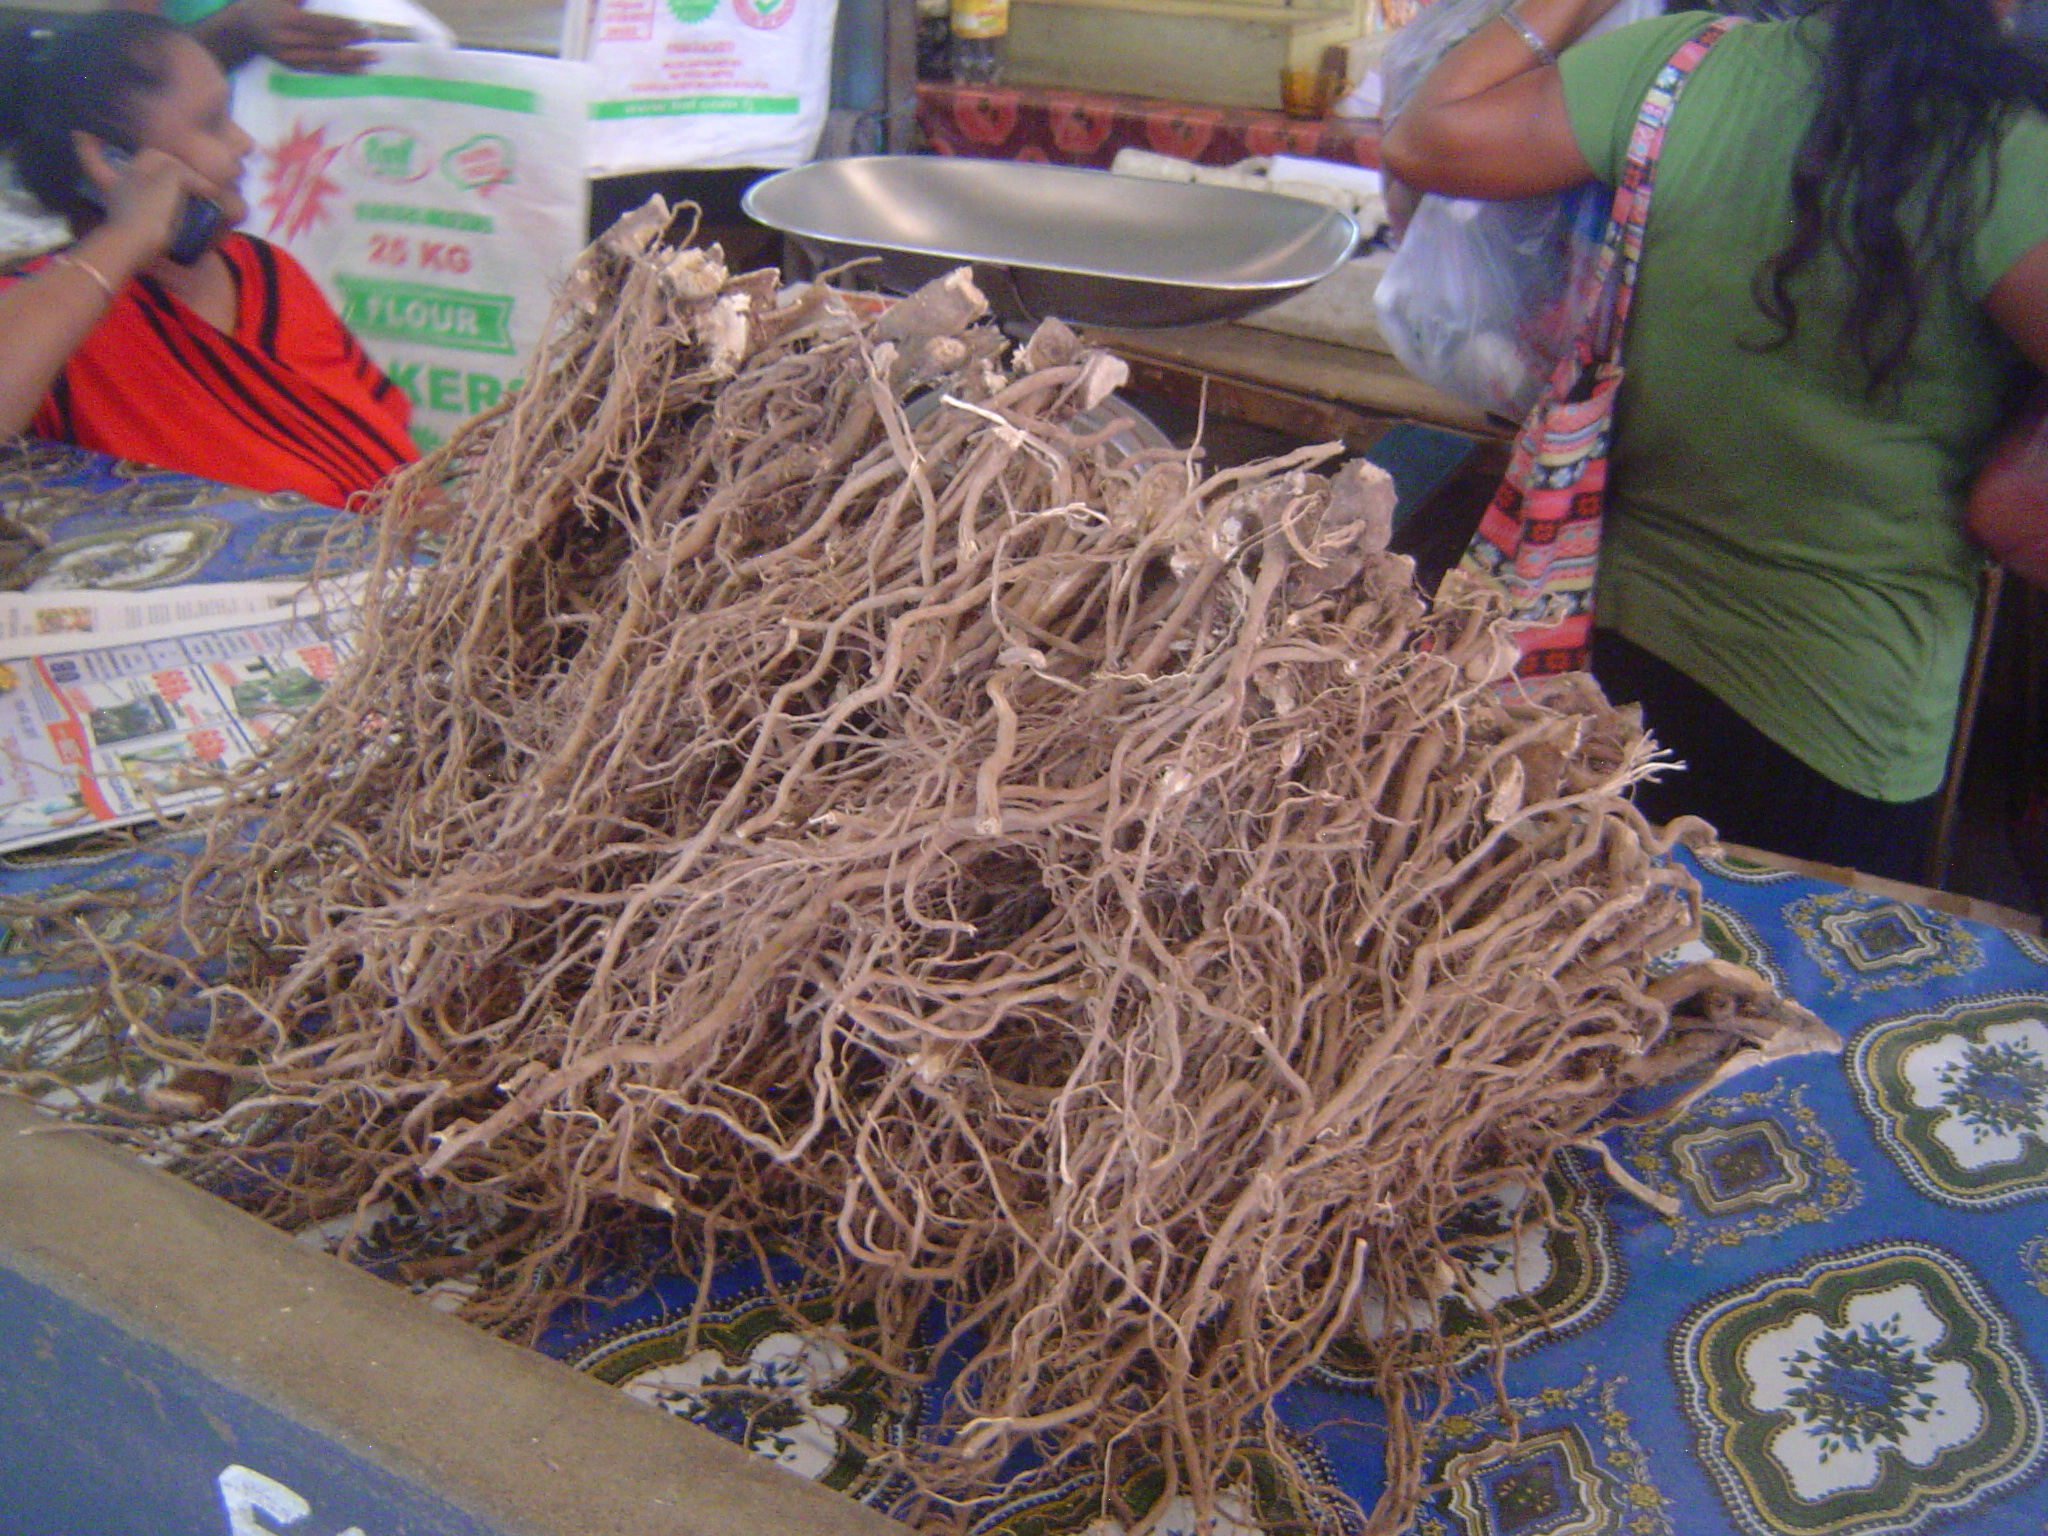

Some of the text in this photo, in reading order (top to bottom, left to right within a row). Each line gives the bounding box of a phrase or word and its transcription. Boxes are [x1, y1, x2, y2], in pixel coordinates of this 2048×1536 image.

[367, 233, 472, 275] 25 KG
[366, 295, 479, 336] FLOUR
